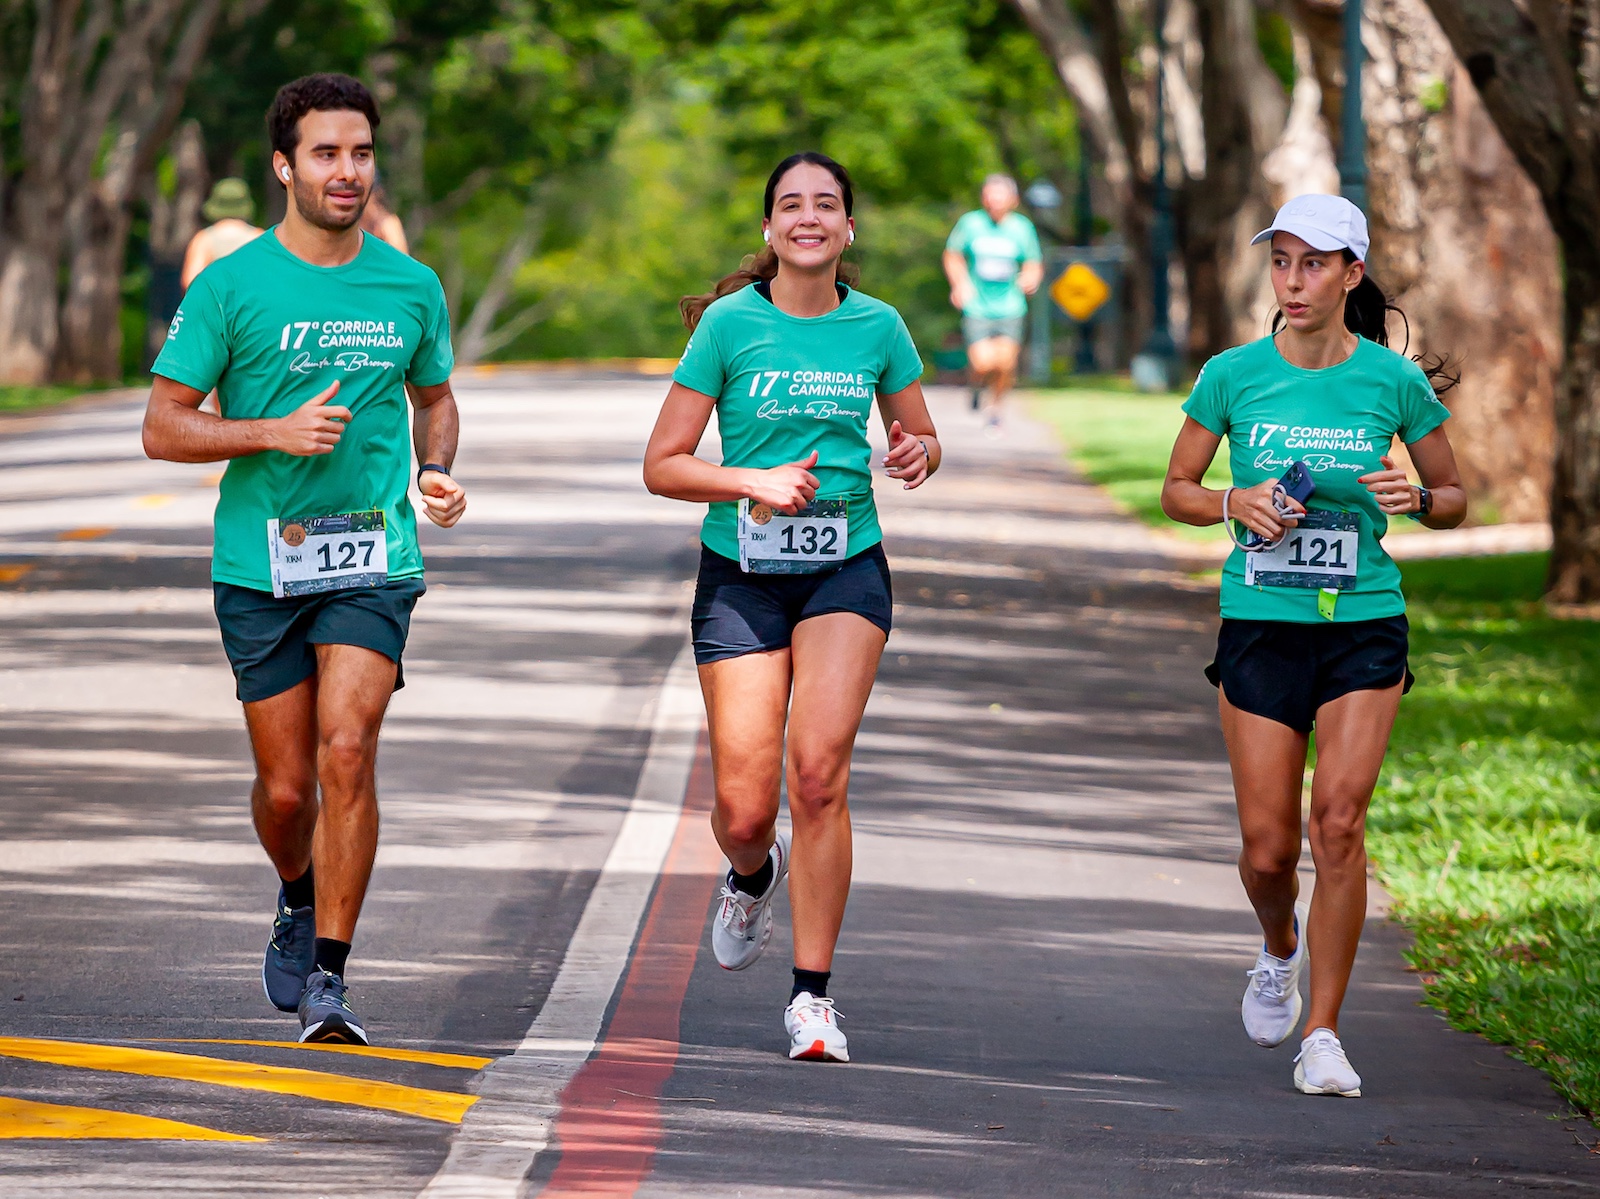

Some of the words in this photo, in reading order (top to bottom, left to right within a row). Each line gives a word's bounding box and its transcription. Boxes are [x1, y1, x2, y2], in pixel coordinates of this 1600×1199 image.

[322, 320, 385, 334] CORRIDA
[387, 321, 396, 334] E
[318, 334, 404, 348] CAMINHADA
[289, 351, 331, 374] Quinta
[333, 357, 346, 367] da
[792, 370, 855, 384] CORRIDA
[856, 373, 864, 385] E
[788, 383, 870, 399] CAMINHADA
[756, 399, 801, 421] Quinta
[1289, 426, 1354, 439] CORRIDA
[1356, 428, 1366, 439] E
[1284, 438, 1374, 453] CAMINHADA
[1253, 449, 1294, 471] Quinta
[755, 510, 769, 520] 25
[751, 532, 767, 541] 10KM
[780, 524, 838, 555] 132
[285, 554, 303, 563] 10KM
[317, 540, 375, 572] 127
[1288, 536, 1348, 569] 121
